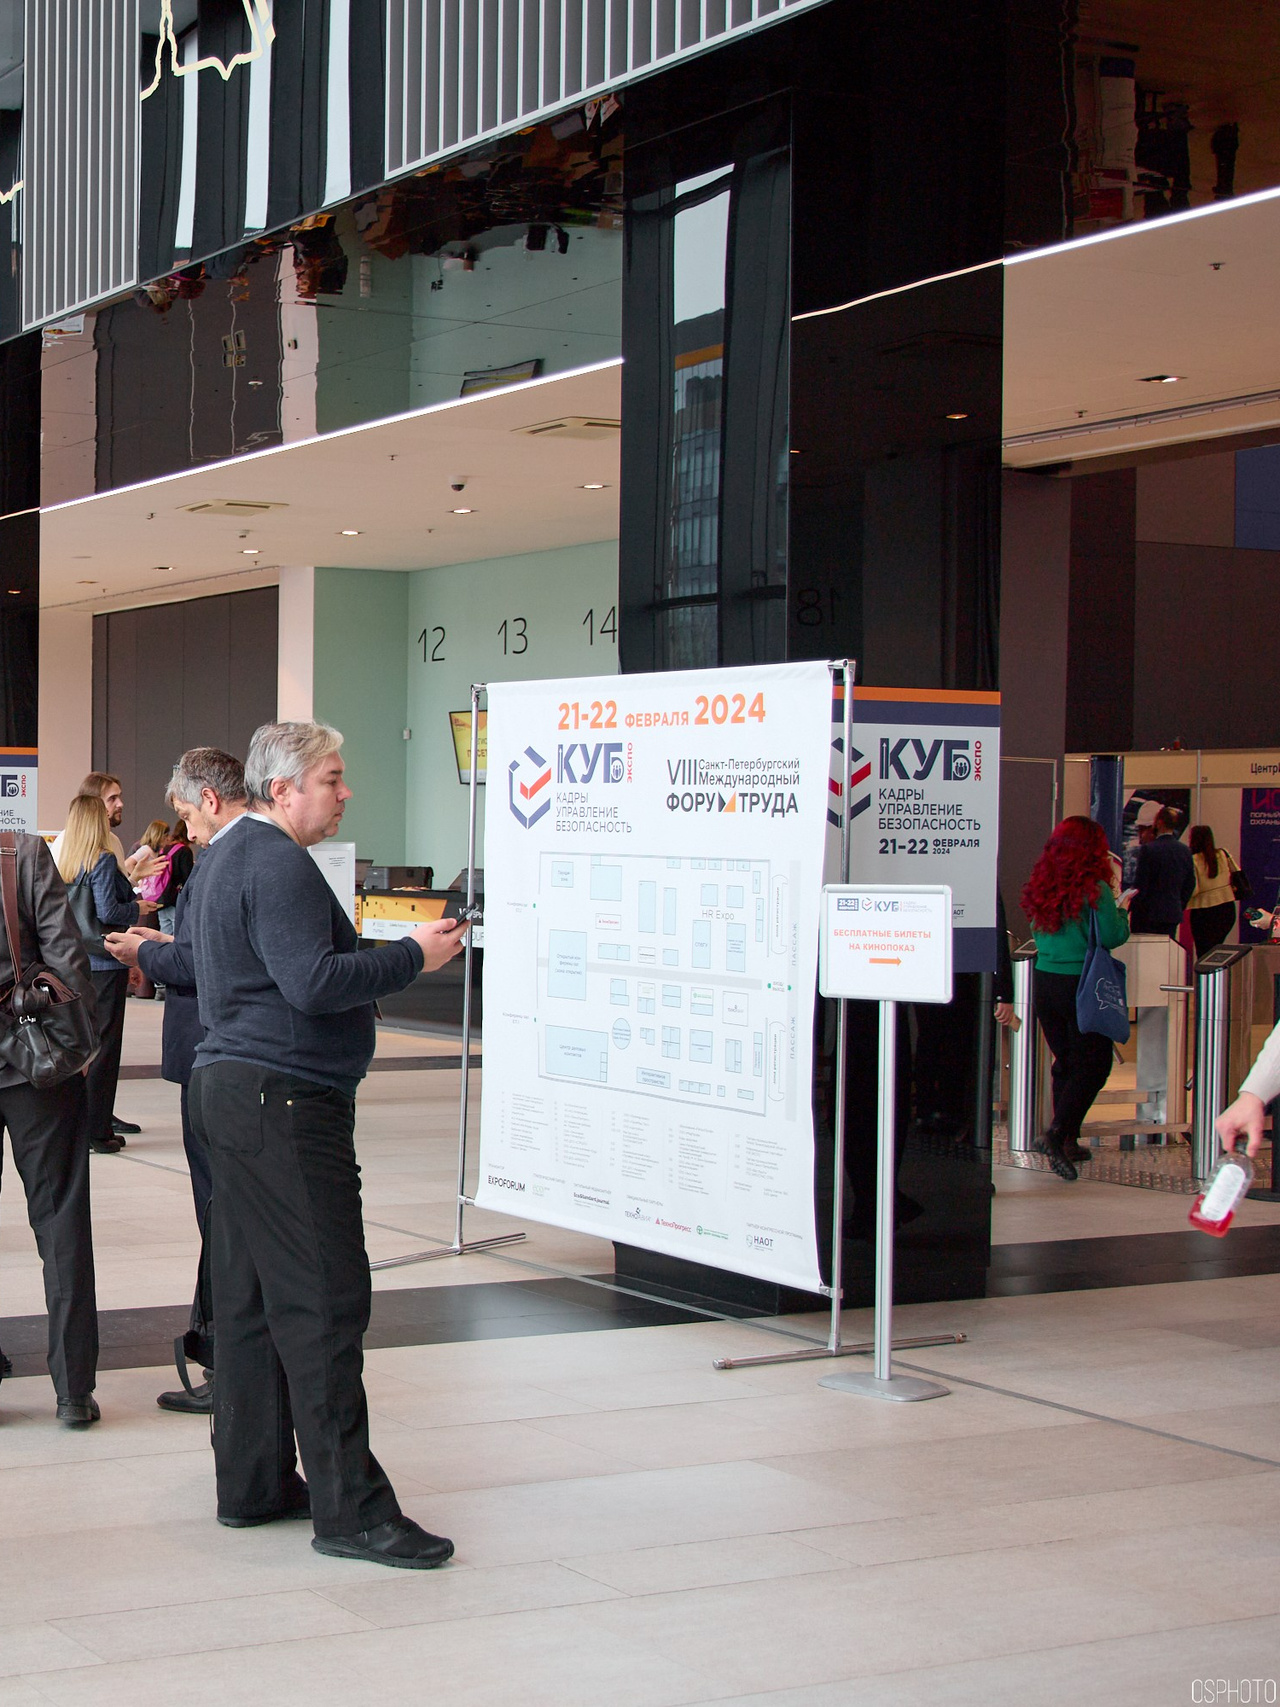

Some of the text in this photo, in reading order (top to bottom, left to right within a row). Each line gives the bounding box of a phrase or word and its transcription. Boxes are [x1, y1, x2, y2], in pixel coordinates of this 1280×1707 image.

[583, 606, 618, 646] 14
[497, 617, 528, 655] 13
[417, 626, 446, 662] 12
[558, 692, 766, 730] 21-22 ФЕВРАЛЯ 2024
[557, 743, 624, 784] КУБ
[698, 758, 800, 771] Санкт-Петербургский
[879, 737, 972, 781] КУБ
[667, 759, 697, 785] VIII
[698, 771, 800, 788] Международный
[556, 792, 589, 804] КАДРЫ
[879, 788, 924, 802] КАДРЫ
[556, 805, 618, 819] УПРАВЛЕНИЕ
[738, 792, 799, 818] ТРУДА
[879, 803, 962, 816] УПРАВЛЕНИЕ
[555, 820, 632, 833] БЕЗОПАСНОСТЬ
[878, 818, 981, 831] БЕЗОПАСНОСТЬ
[879, 838, 928, 855] 21-22
[932, 839, 980, 848] ФЕВРАЛЯ
[874, 901, 899, 912] КУБ
[702, 909, 735, 921] HR Expo
[834, 929, 931, 939] БЕСПЛАТНЫЕ БИЛЕТЫ
[863, 943, 915, 952] КИНОПОКАЗ
[488, 1175, 526, 1192] EXPOFORUM
[754, 1235, 774, 1248] НАОТ
